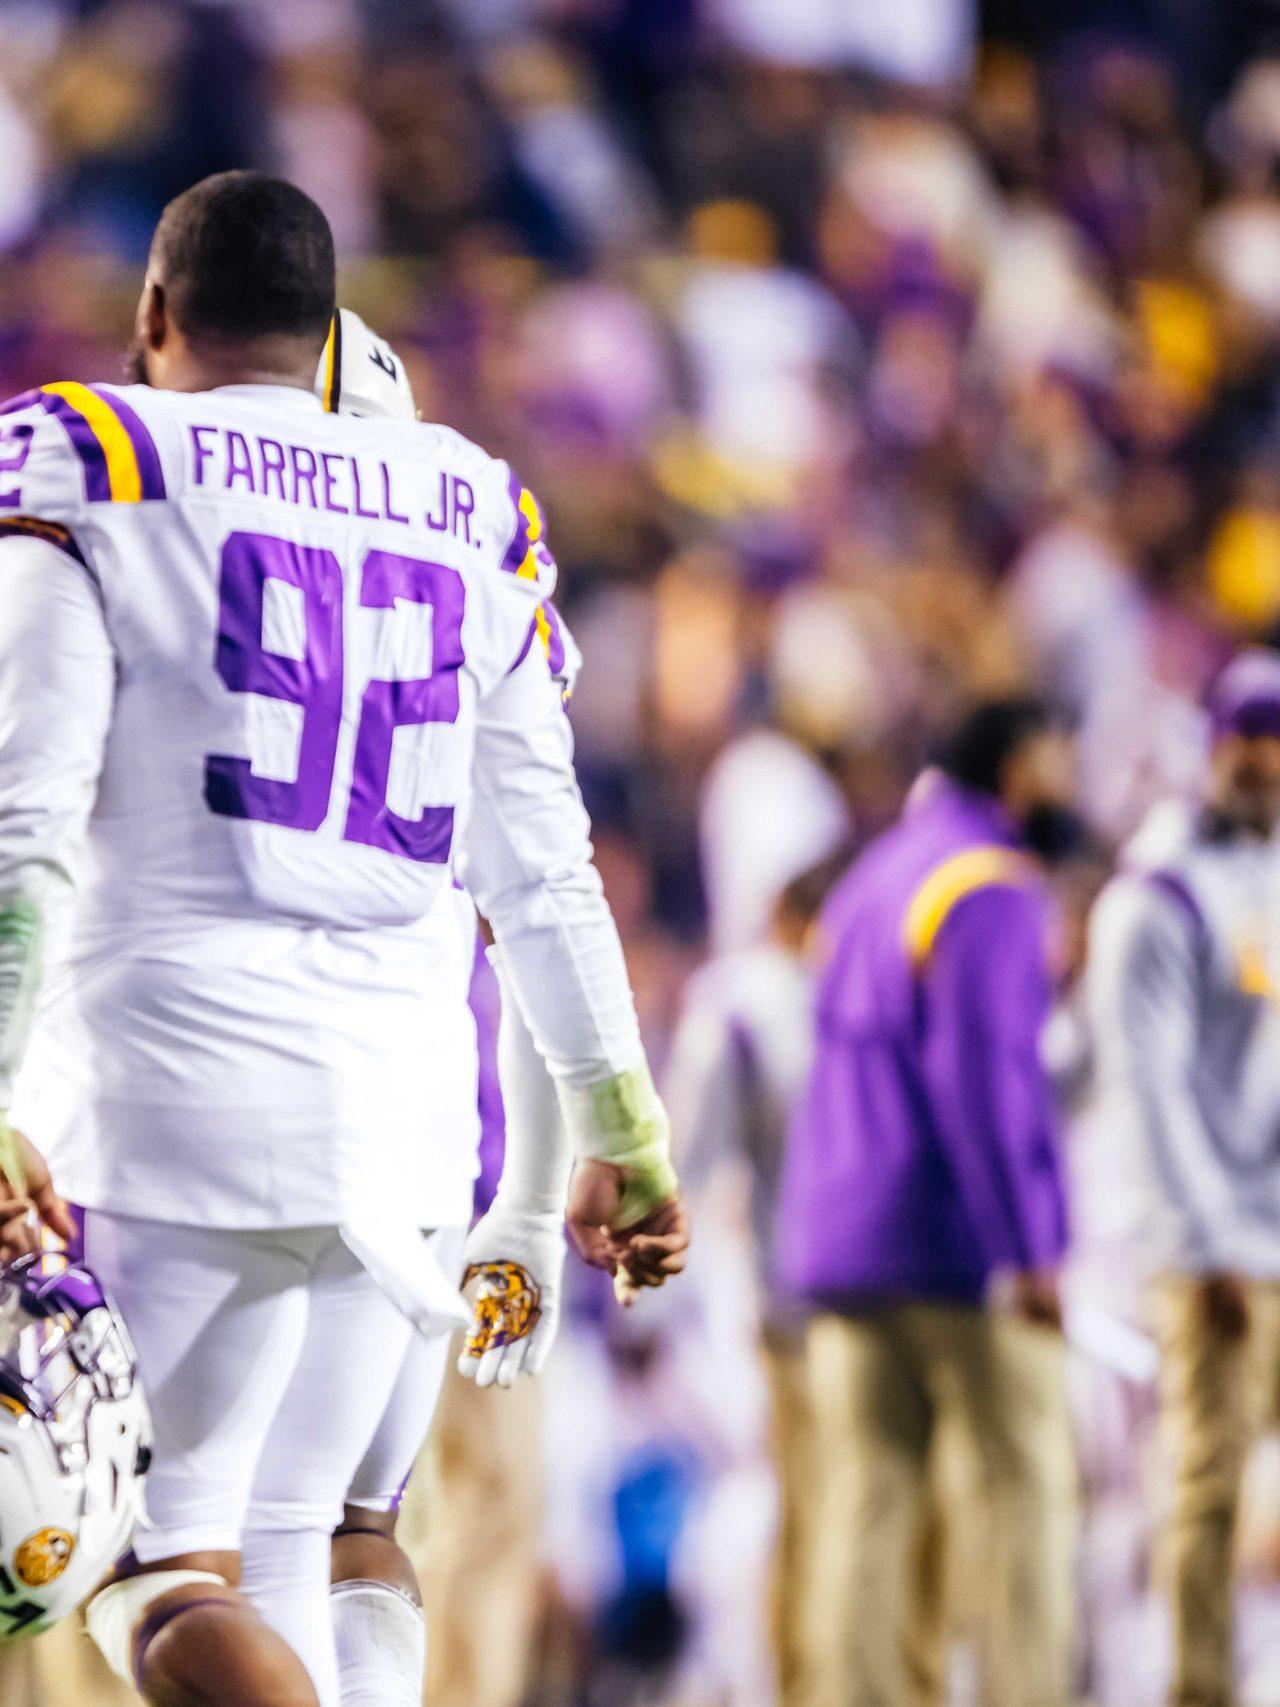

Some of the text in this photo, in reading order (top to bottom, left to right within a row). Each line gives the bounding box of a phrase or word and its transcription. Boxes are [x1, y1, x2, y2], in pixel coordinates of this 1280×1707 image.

[189, 426, 481, 549] FARRELL JR.
[203, 531, 465, 865] 92
